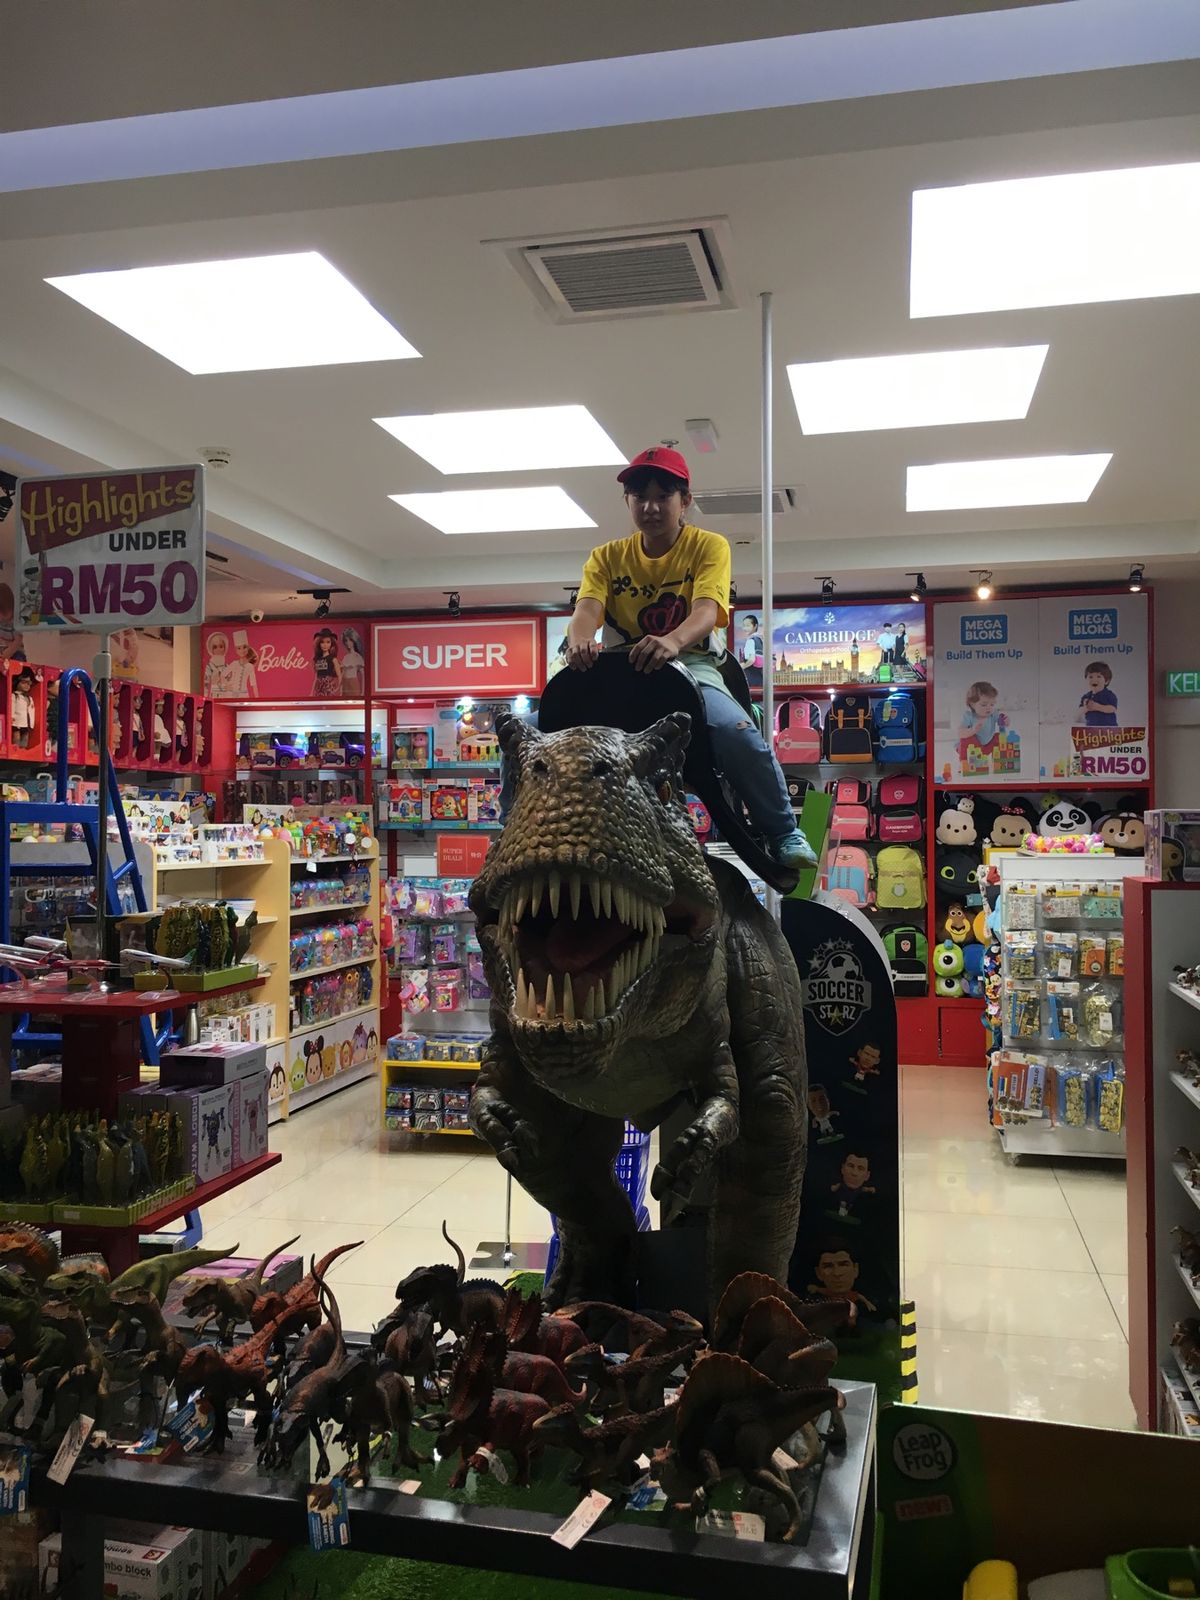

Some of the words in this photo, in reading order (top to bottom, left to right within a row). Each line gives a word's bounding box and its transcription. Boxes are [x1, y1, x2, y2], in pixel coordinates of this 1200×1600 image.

[21, 474, 195, 537] Highlights
[108, 529, 187, 552] UNDER
[41, 560, 199, 616] RM50
[965, 620, 1002, 630] MEGA
[1073, 614, 1111, 625] MEGA
[785, 629, 876, 644] CAMBRIDGE
[965, 630, 1003, 641] BLOKS
[1073, 624, 1113, 635] BLOKS
[258, 644, 310, 672] Barbie
[401, 643, 508, 670] SUPER
[946, 649, 972, 660] Build
[976, 649, 1005, 660] Them
[1008, 649, 1023, 660] Up
[1053, 645, 1080, 656] Build
[1084, 644, 1114, 655] Them
[1117, 644, 1133, 656] Up
[1072, 728, 1146, 747] Highlights
[1081, 756, 1147, 775] RM50
[808, 980, 864, 1002] SOCCER
[191, 1097, 199, 1136] ROBOT
[898, 1432, 941, 1453] Leap
[903, 1451, 948, 1472] Frog
[125, 1564, 151, 1578] block
